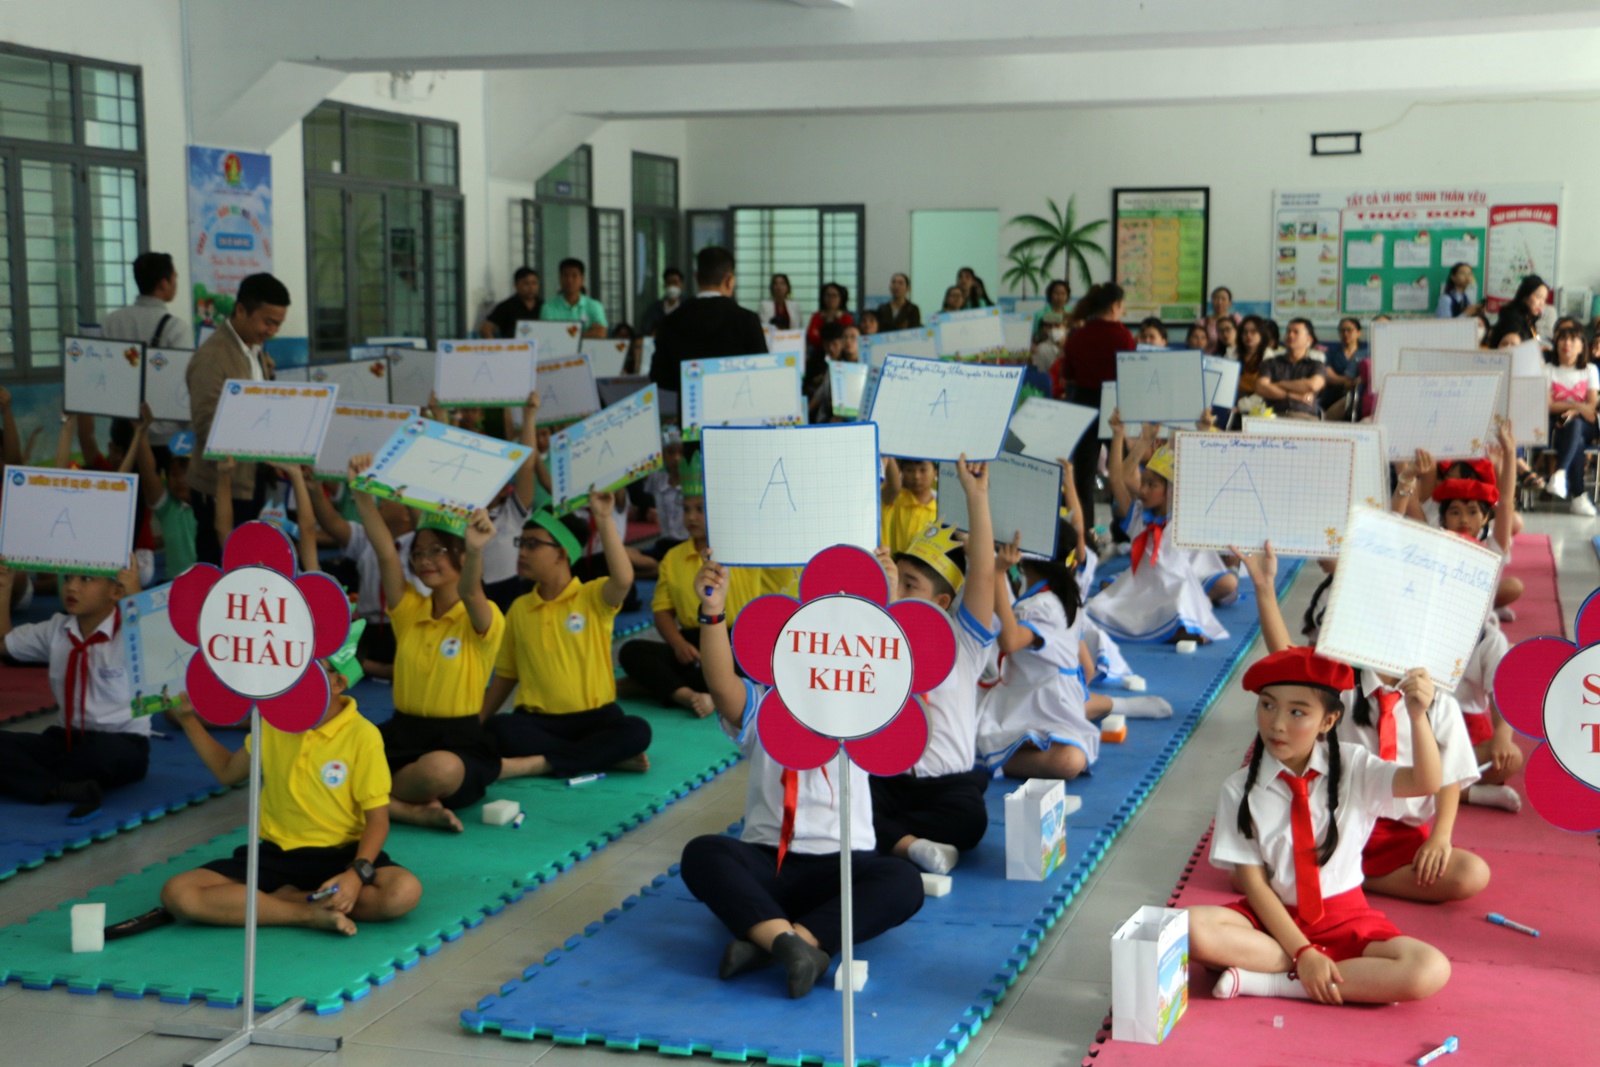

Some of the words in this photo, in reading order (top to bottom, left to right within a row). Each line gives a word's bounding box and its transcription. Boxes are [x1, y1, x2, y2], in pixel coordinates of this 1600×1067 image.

[1415, 191, 1437, 203] SINH
[928, 387, 960, 419] A
[757, 455, 797, 512] A
[1205, 460, 1269, 528] A
[49, 506, 77, 540] A
[225, 586, 290, 624] HẢI
[207, 628, 307, 669] CHÂU
[786, 629, 901, 661] THANH
[808, 663, 877, 695] KHÊ
[1582, 673, 1600, 706] S
[1580, 722, 1600, 754] T
